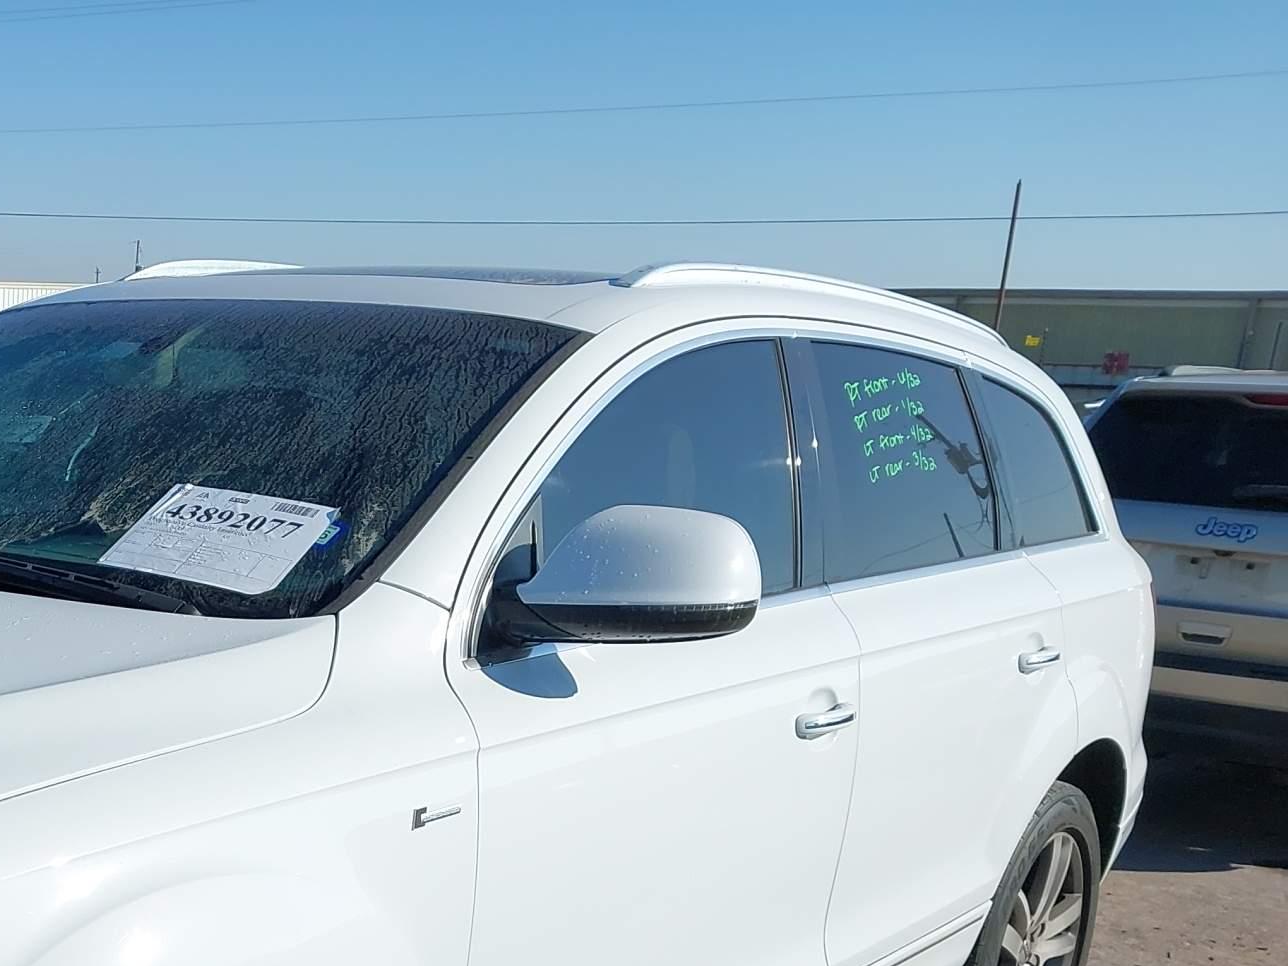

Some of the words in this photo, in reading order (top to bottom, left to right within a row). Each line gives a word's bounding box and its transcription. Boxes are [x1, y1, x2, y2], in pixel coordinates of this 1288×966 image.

[872, 404, 892, 422] rear
[885, 460, 904, 476] rear
[166, 503, 304, 538] 43892077
[1195, 517, 1258, 544] Jeep
